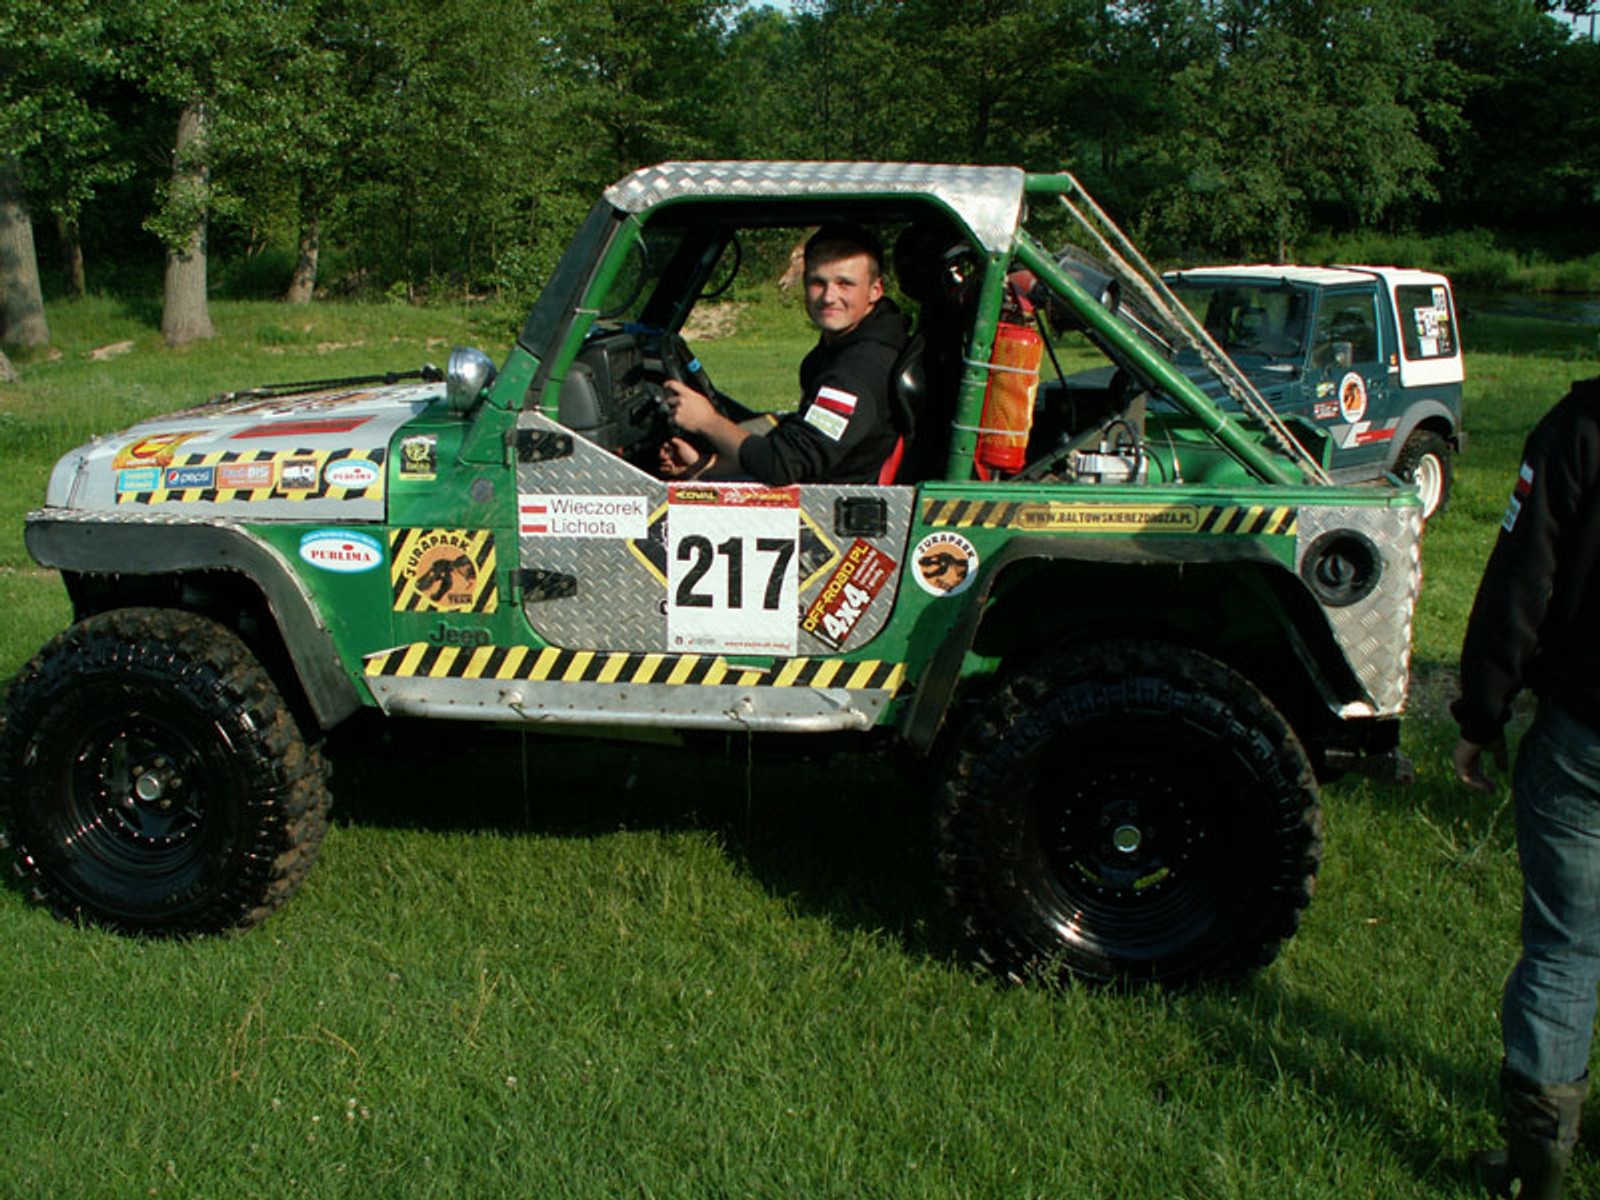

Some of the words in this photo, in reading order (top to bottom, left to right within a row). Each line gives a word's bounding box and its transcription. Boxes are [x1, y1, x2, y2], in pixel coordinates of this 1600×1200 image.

[180, 472, 209, 484] pepsi
[551, 499, 643, 515] Wieczorek
[551, 519, 617, 535] Lichota
[311, 549, 372, 561] PUBLIMA
[406, 534, 470, 577] JURAPARK
[918, 533, 975, 559] JURAPARK
[675, 534, 796, 610] 217
[823, 583, 871, 640] 4x4
[429, 620, 491, 646] Jeep
